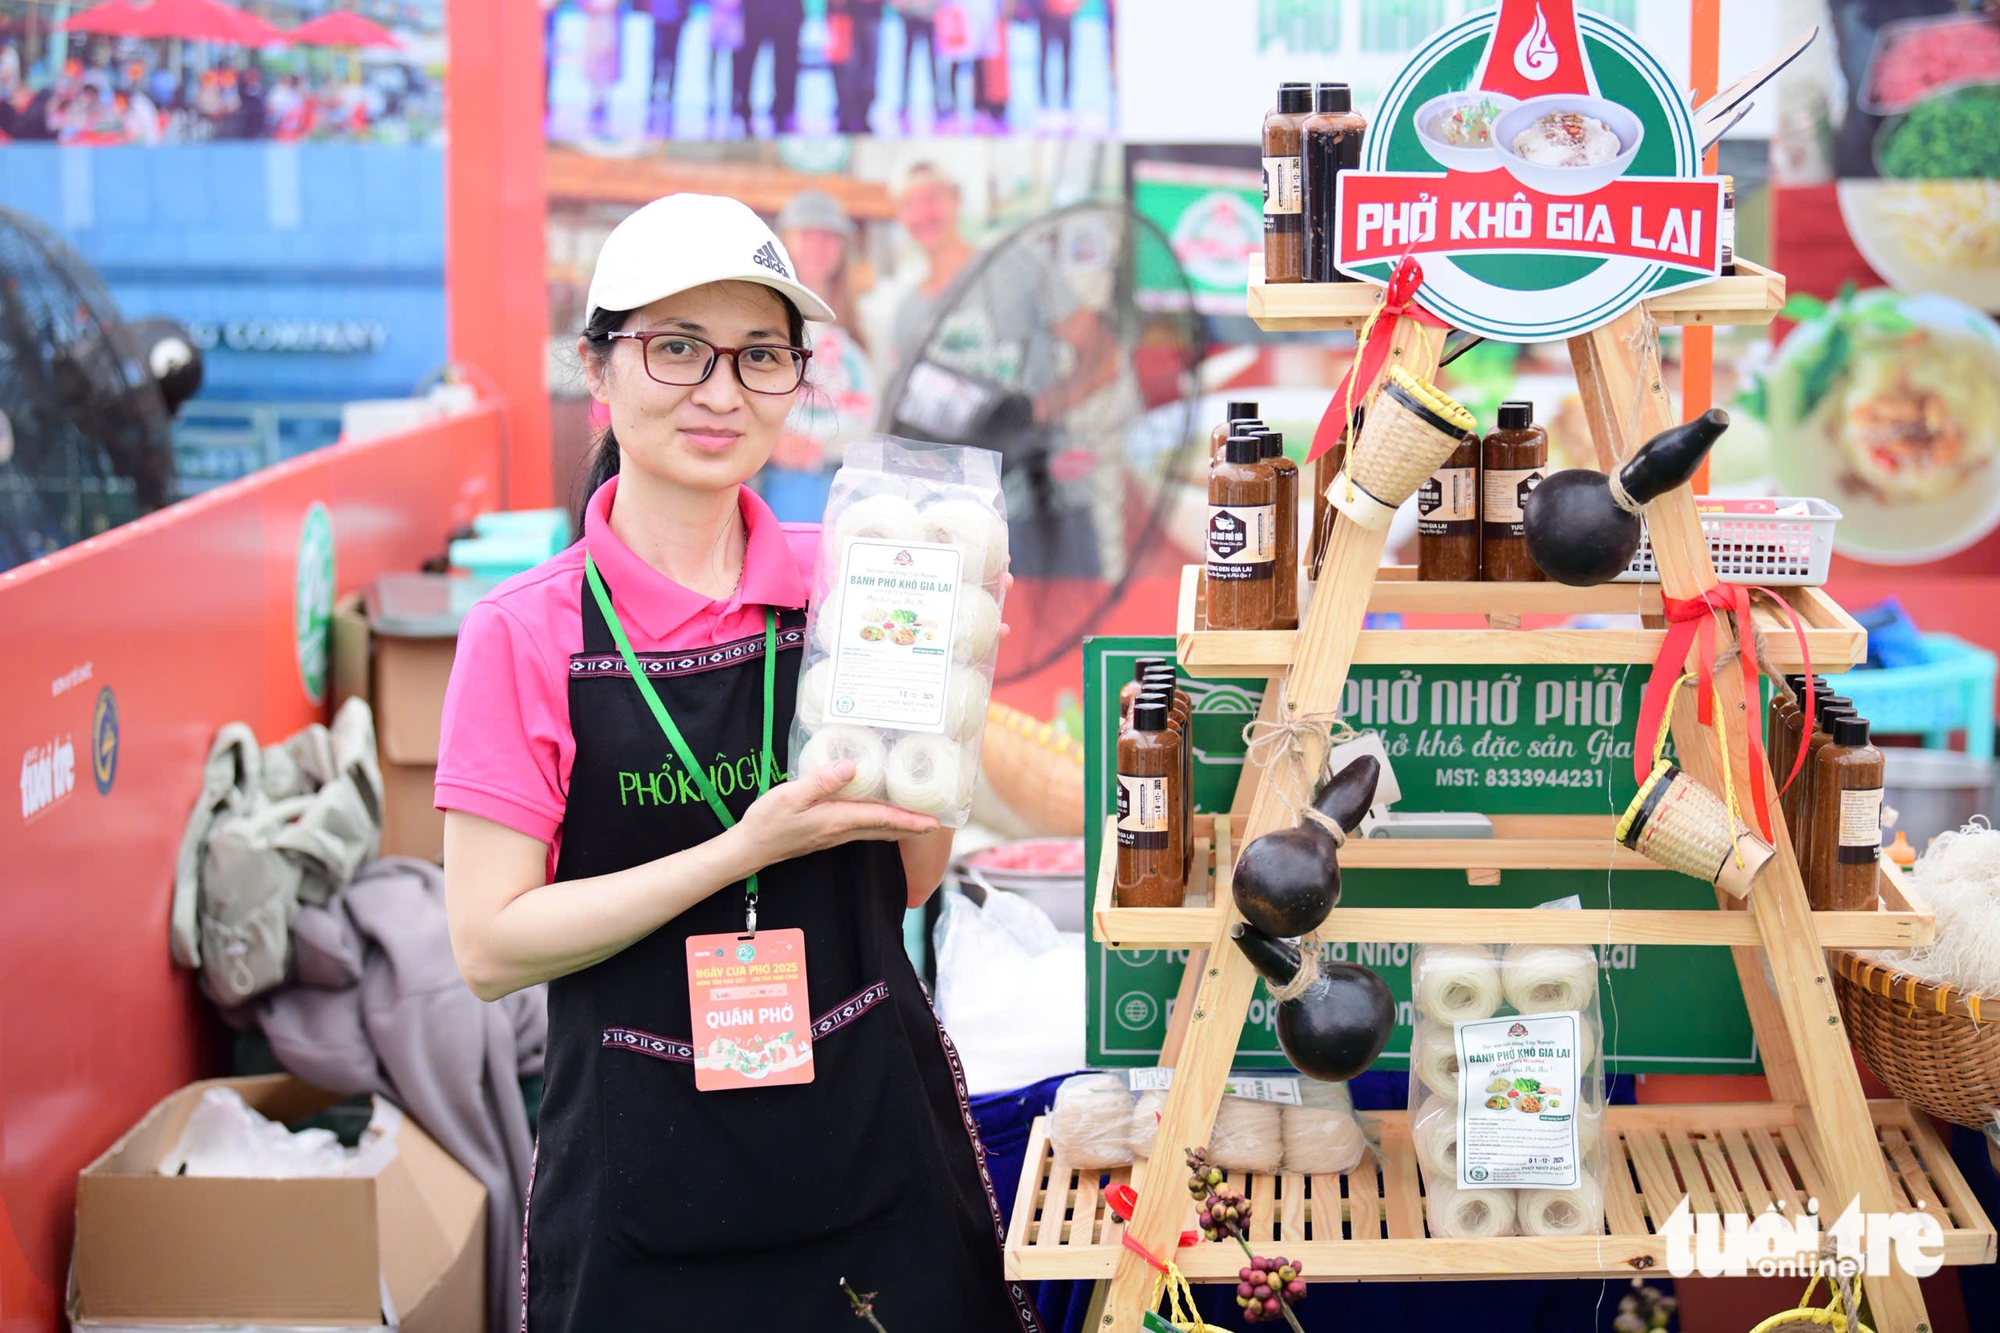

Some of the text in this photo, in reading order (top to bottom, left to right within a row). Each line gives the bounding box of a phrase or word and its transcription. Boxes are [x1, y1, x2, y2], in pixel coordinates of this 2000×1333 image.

[1356, 192, 1702, 258] PHỞ KHÔ GIA LAI
[919, 580, 935, 592] GIA
[938, 582, 952, 593] LAI
[1335, 670, 1422, 725] PHỞ
[1535, 667, 1622, 727] PHỐ
[1416, 729, 1465, 757] khô
[1471, 728, 1522, 762] đặc
[1527, 734, 1577, 757] sản
[1587, 729, 1635, 765] Gia
[1435, 768, 1603, 787] MST: 8333944231
[773, 962, 798, 973] 2025
[758, 1002, 794, 1024] PHỞ
[1469, 1046, 1571, 1063] BÁNH PHỞ KHÔ GIA LAI
